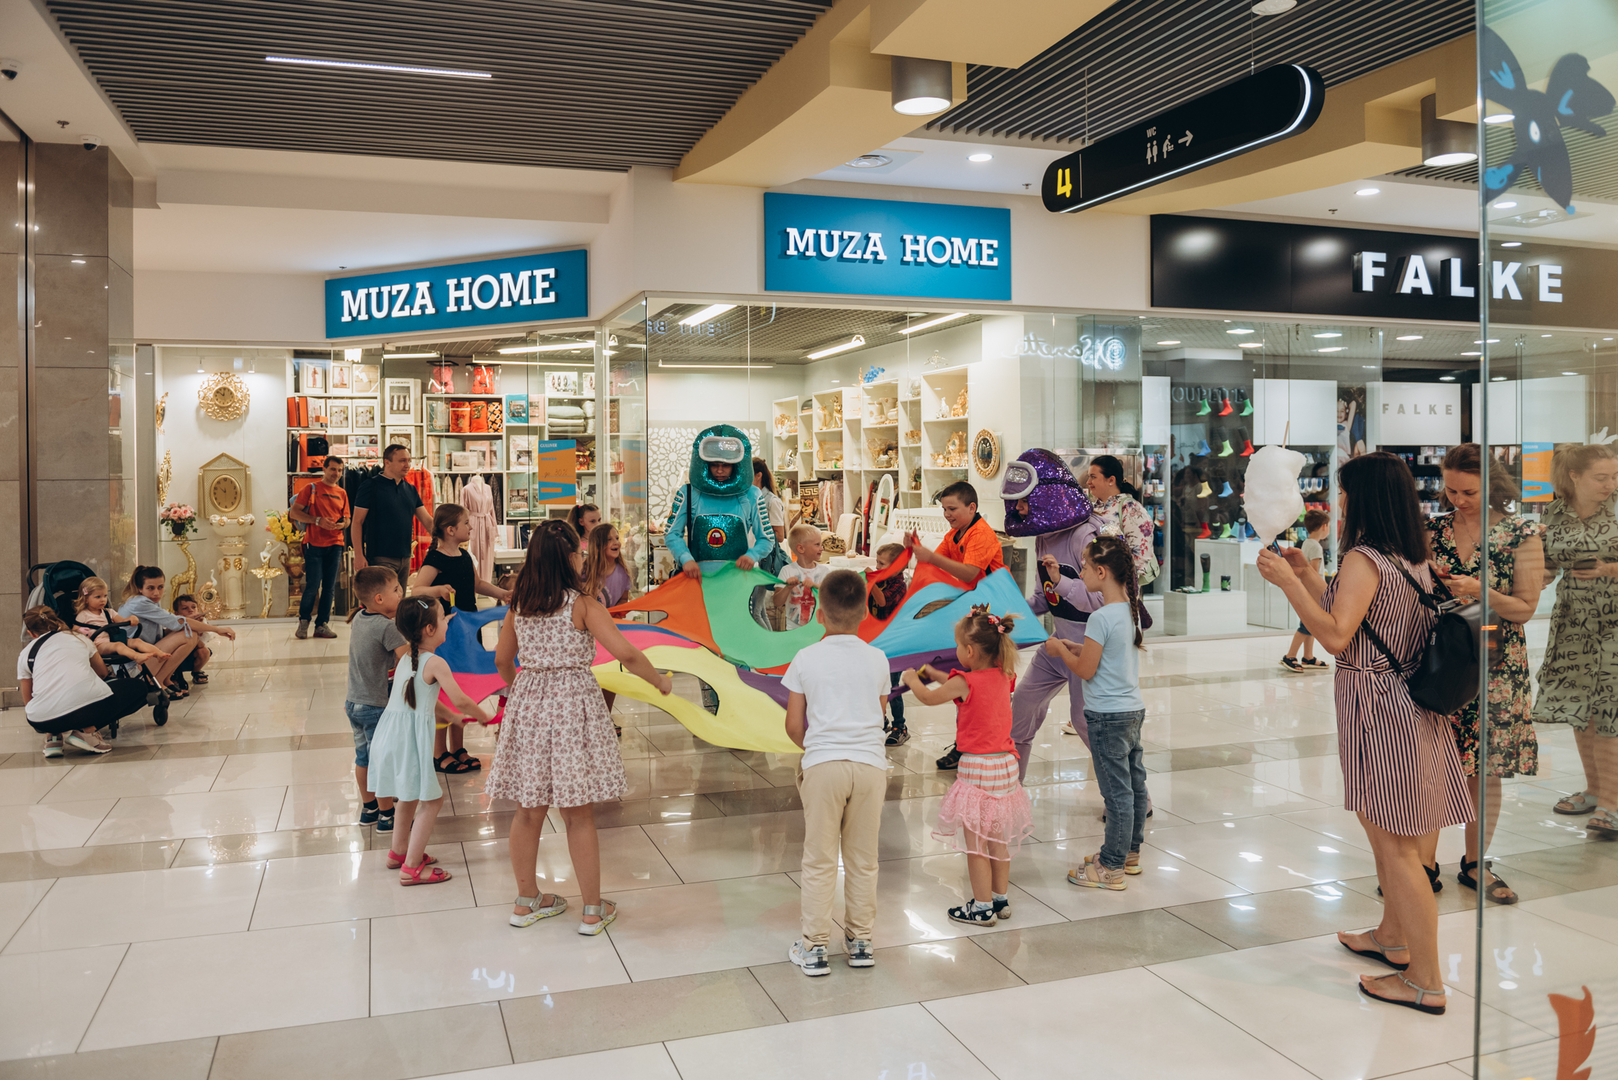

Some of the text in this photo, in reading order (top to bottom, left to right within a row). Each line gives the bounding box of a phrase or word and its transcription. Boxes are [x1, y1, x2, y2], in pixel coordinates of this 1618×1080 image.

[1147, 126, 1156, 138] WC
[1057, 168, 1072, 198] 4
[786, 227, 998, 266] MUZA HOME
[1360, 251, 1563, 303] FALKE
[341, 267, 556, 322] MUZA HOME
[1382, 403, 1453, 415] FALKE
